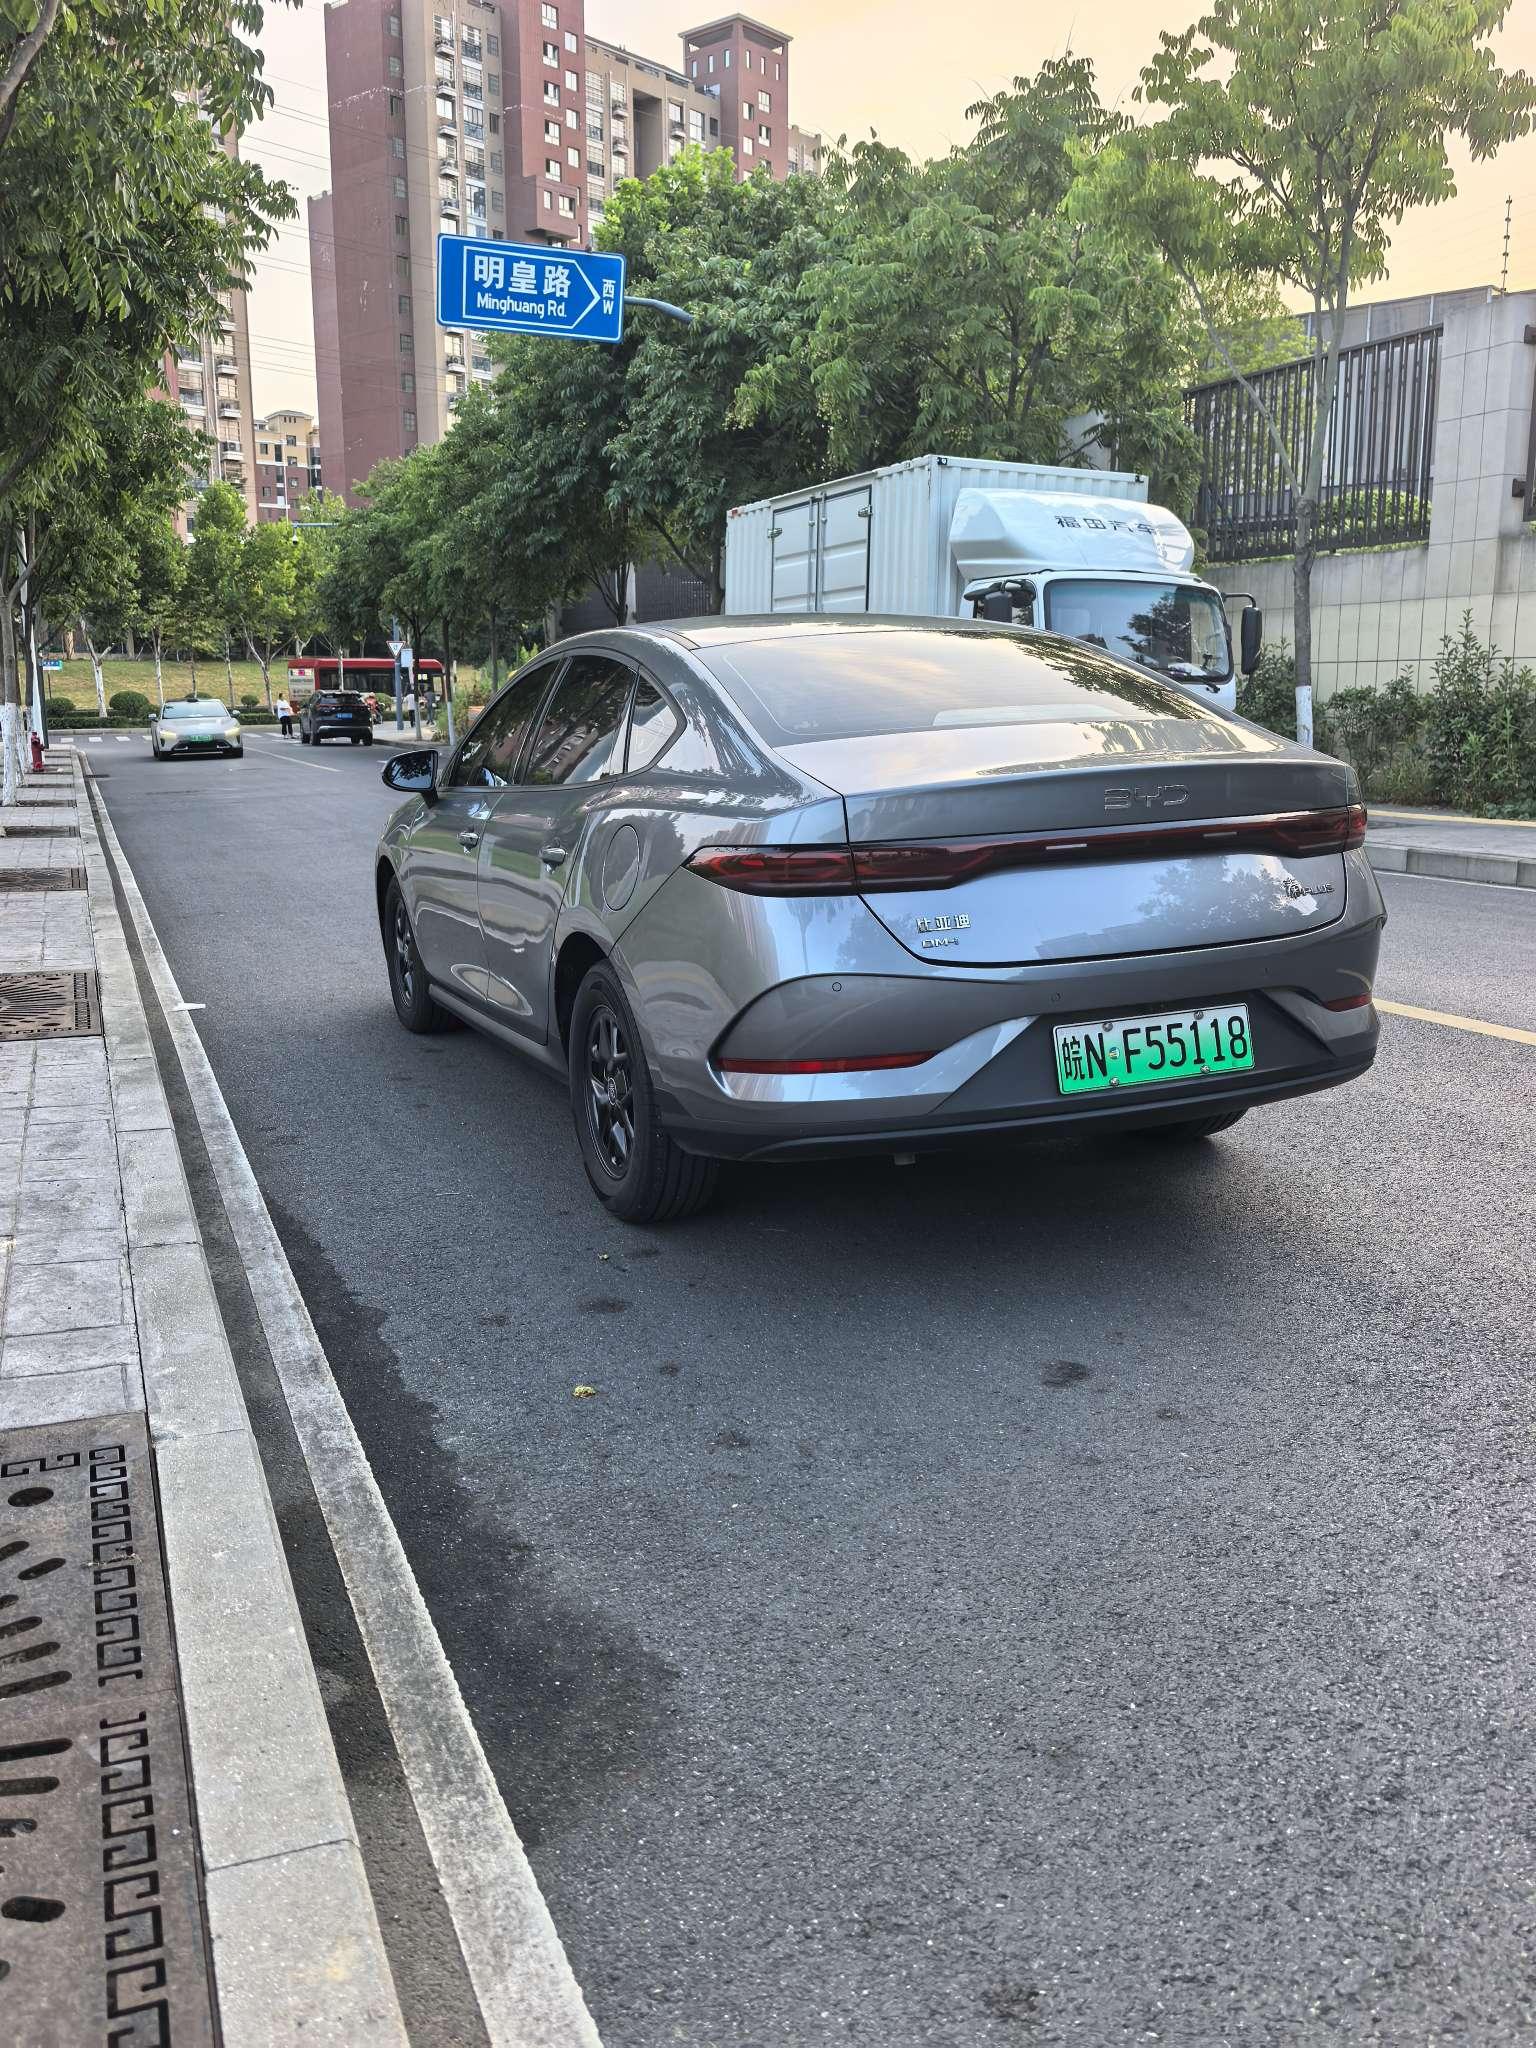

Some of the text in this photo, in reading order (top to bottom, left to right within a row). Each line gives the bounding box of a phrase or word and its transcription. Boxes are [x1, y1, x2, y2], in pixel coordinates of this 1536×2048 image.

[473, 254, 572, 299] 明皇路
[601, 278, 616, 298] 西
[476, 291, 568, 319] Minghuang Rd.
[603, 300, 614, 315] W
[1054, 515, 1155, 535] 福田汽车
[1103, 784, 1191, 811] BYD
[916, 913, 971, 933] 比亚迪
